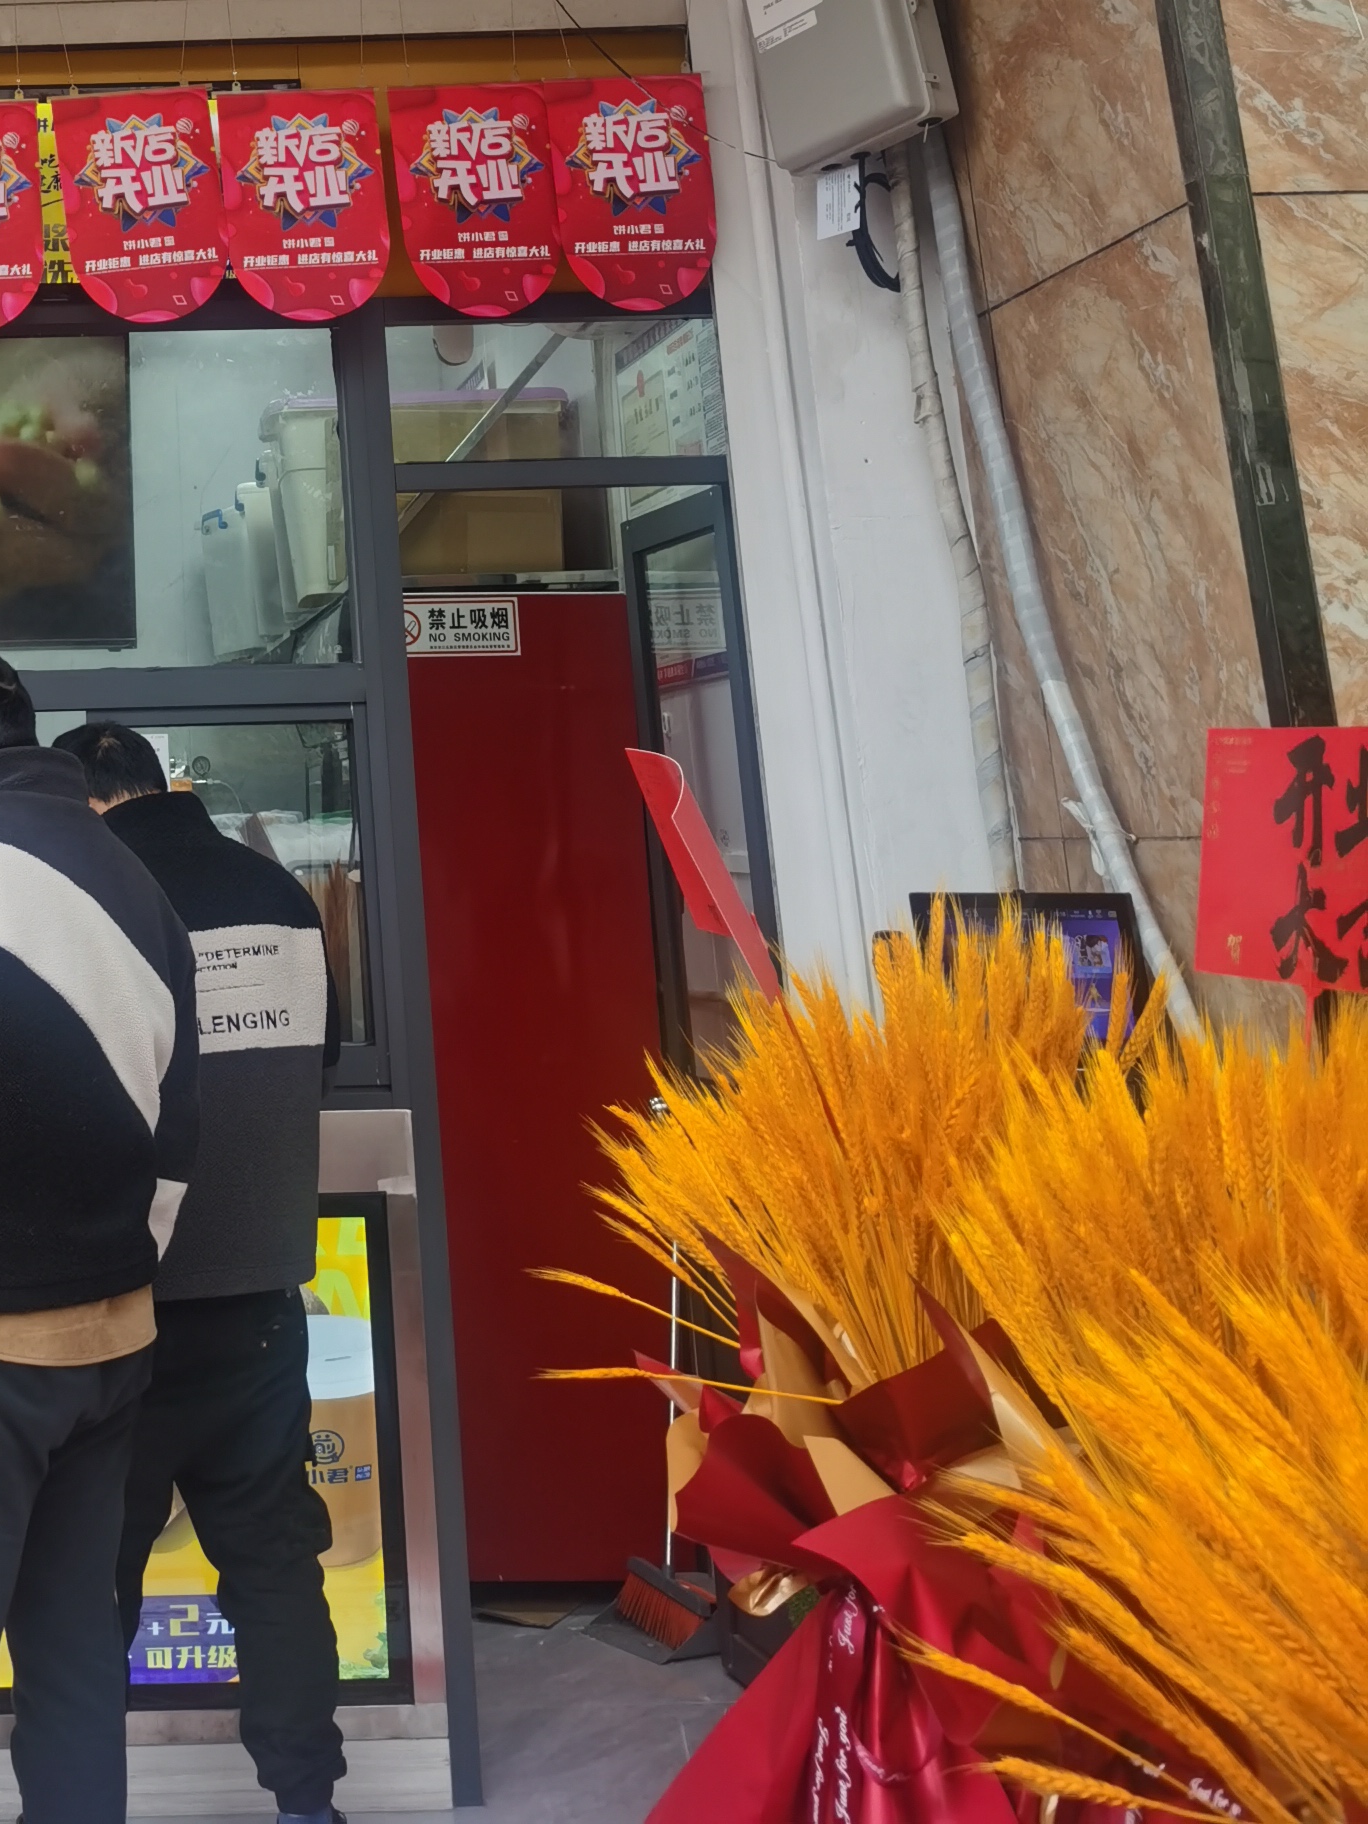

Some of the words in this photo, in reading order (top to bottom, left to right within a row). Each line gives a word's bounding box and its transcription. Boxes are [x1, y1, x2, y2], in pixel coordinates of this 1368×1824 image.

[90, 125, 177, 168] 新店
[254, 126, 342, 167] 新店
[427, 117, 514, 160] 新店
[582, 110, 670, 153] 新店
[97, 165, 187, 214] 开业
[259, 165, 350, 213] 开业
[433, 158, 522, 206] 开业
[589, 151, 679, 199] 开业
[138, 247, 218, 266] 进店有惊喜大礼
[297, 250, 379, 265] 进店有惊喜大礼
[472, 245, 551, 259] 进店有惊喜大礼
[628, 238, 706, 252] 进店有惊喜大礼
[428, 607, 510, 631] 禁止吸烟
[429, 632, 447, 642] NO
[454, 631, 511, 642] SMOKING
[197, 1009, 290, 1036] LENGING
[145, 1645, 238, 1670] 可升级
[835, 1748, 852, 1788] for
